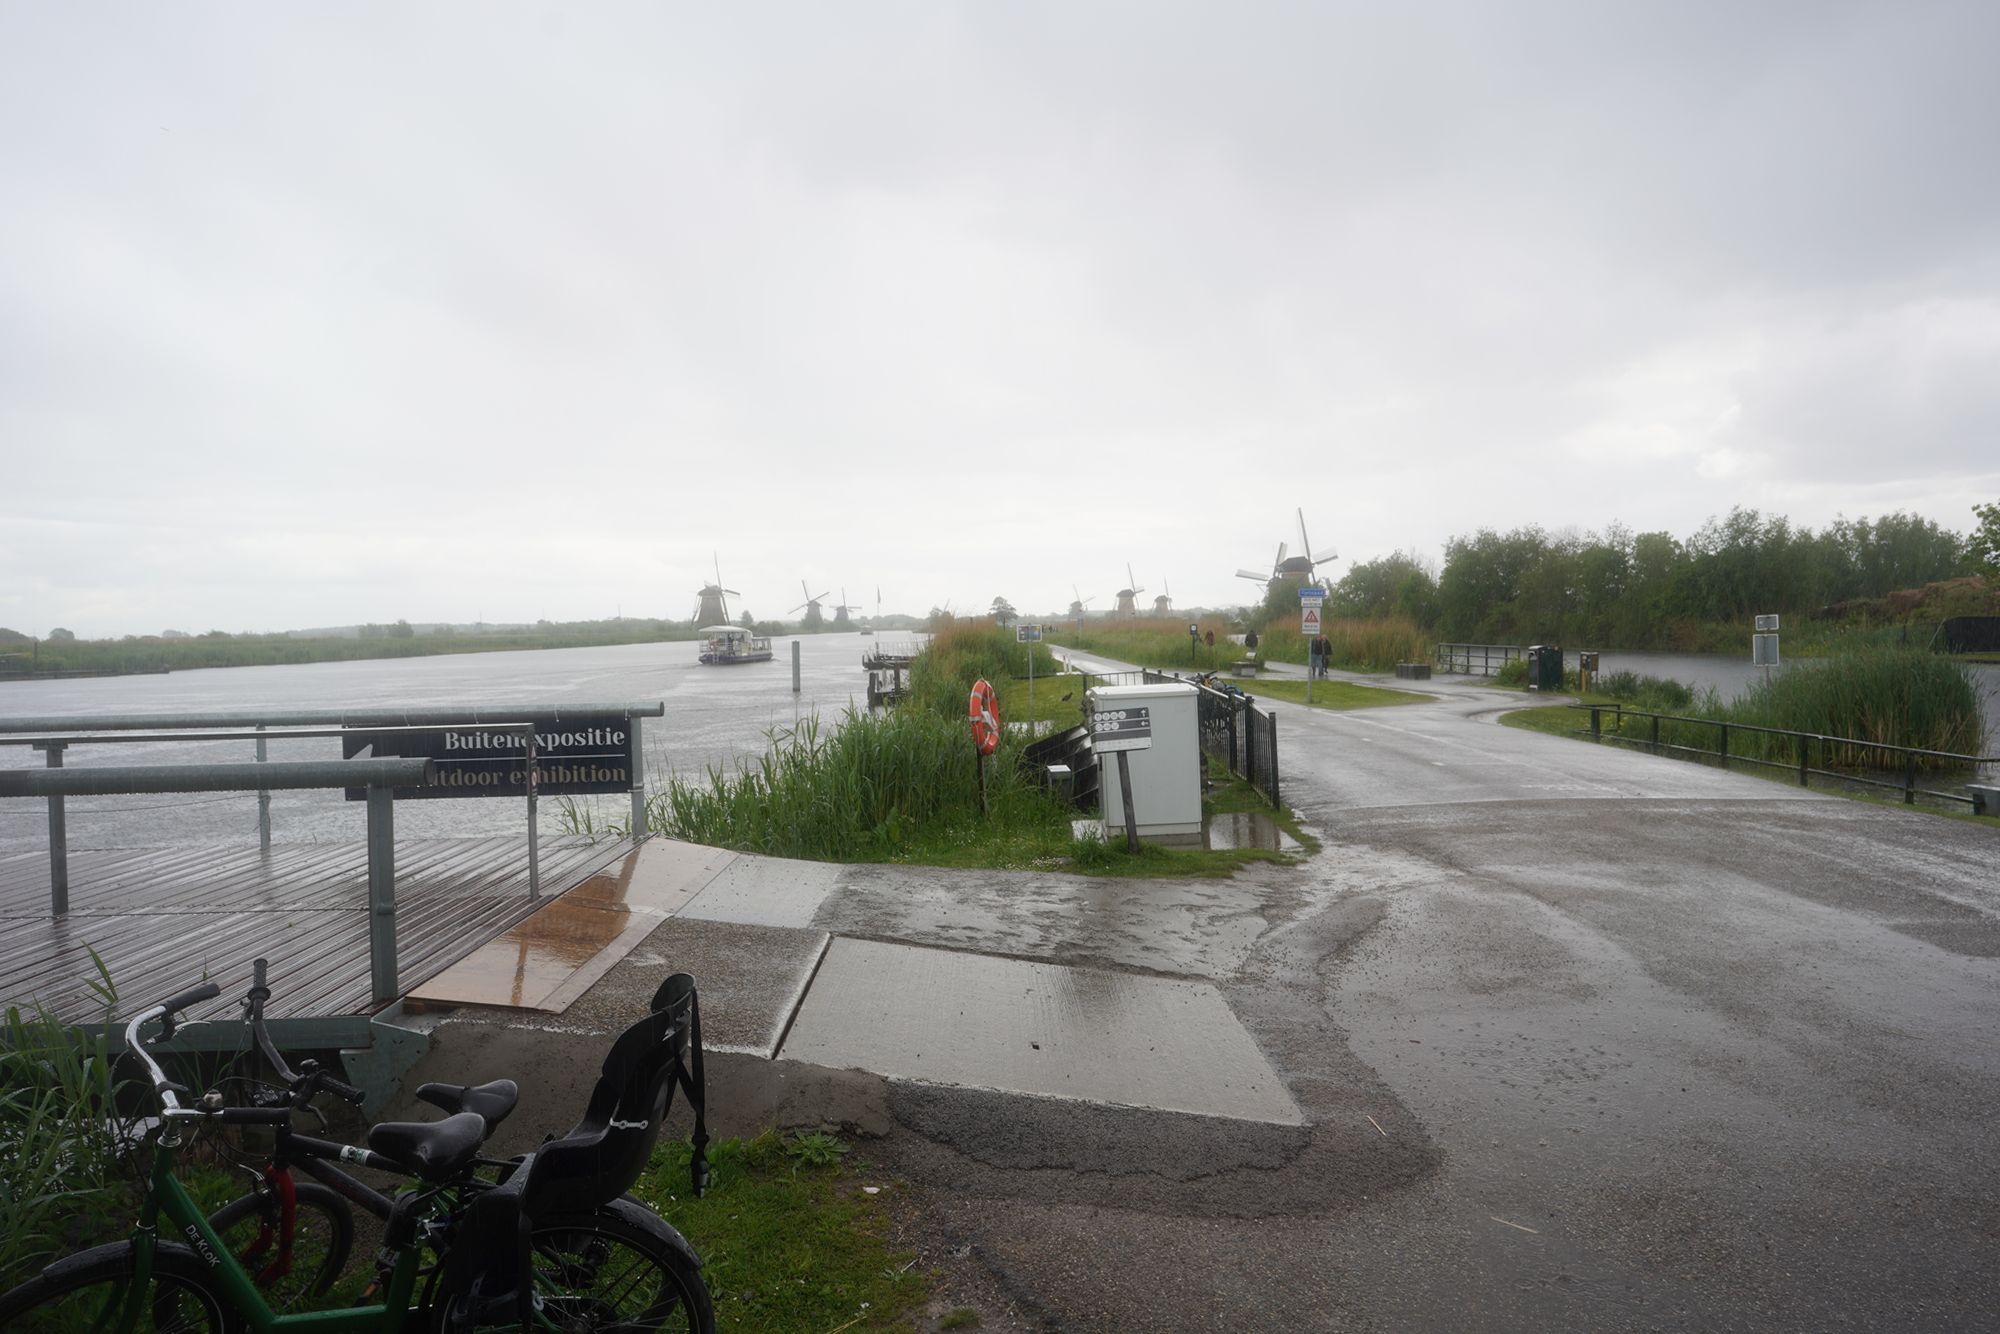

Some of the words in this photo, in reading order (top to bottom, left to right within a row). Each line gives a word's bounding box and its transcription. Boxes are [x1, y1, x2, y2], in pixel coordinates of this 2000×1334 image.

[433, 768, 504, 786] tdoor
[185, 1224, 201, 1242] DE
[196, 1239, 221, 1268] KLOK
